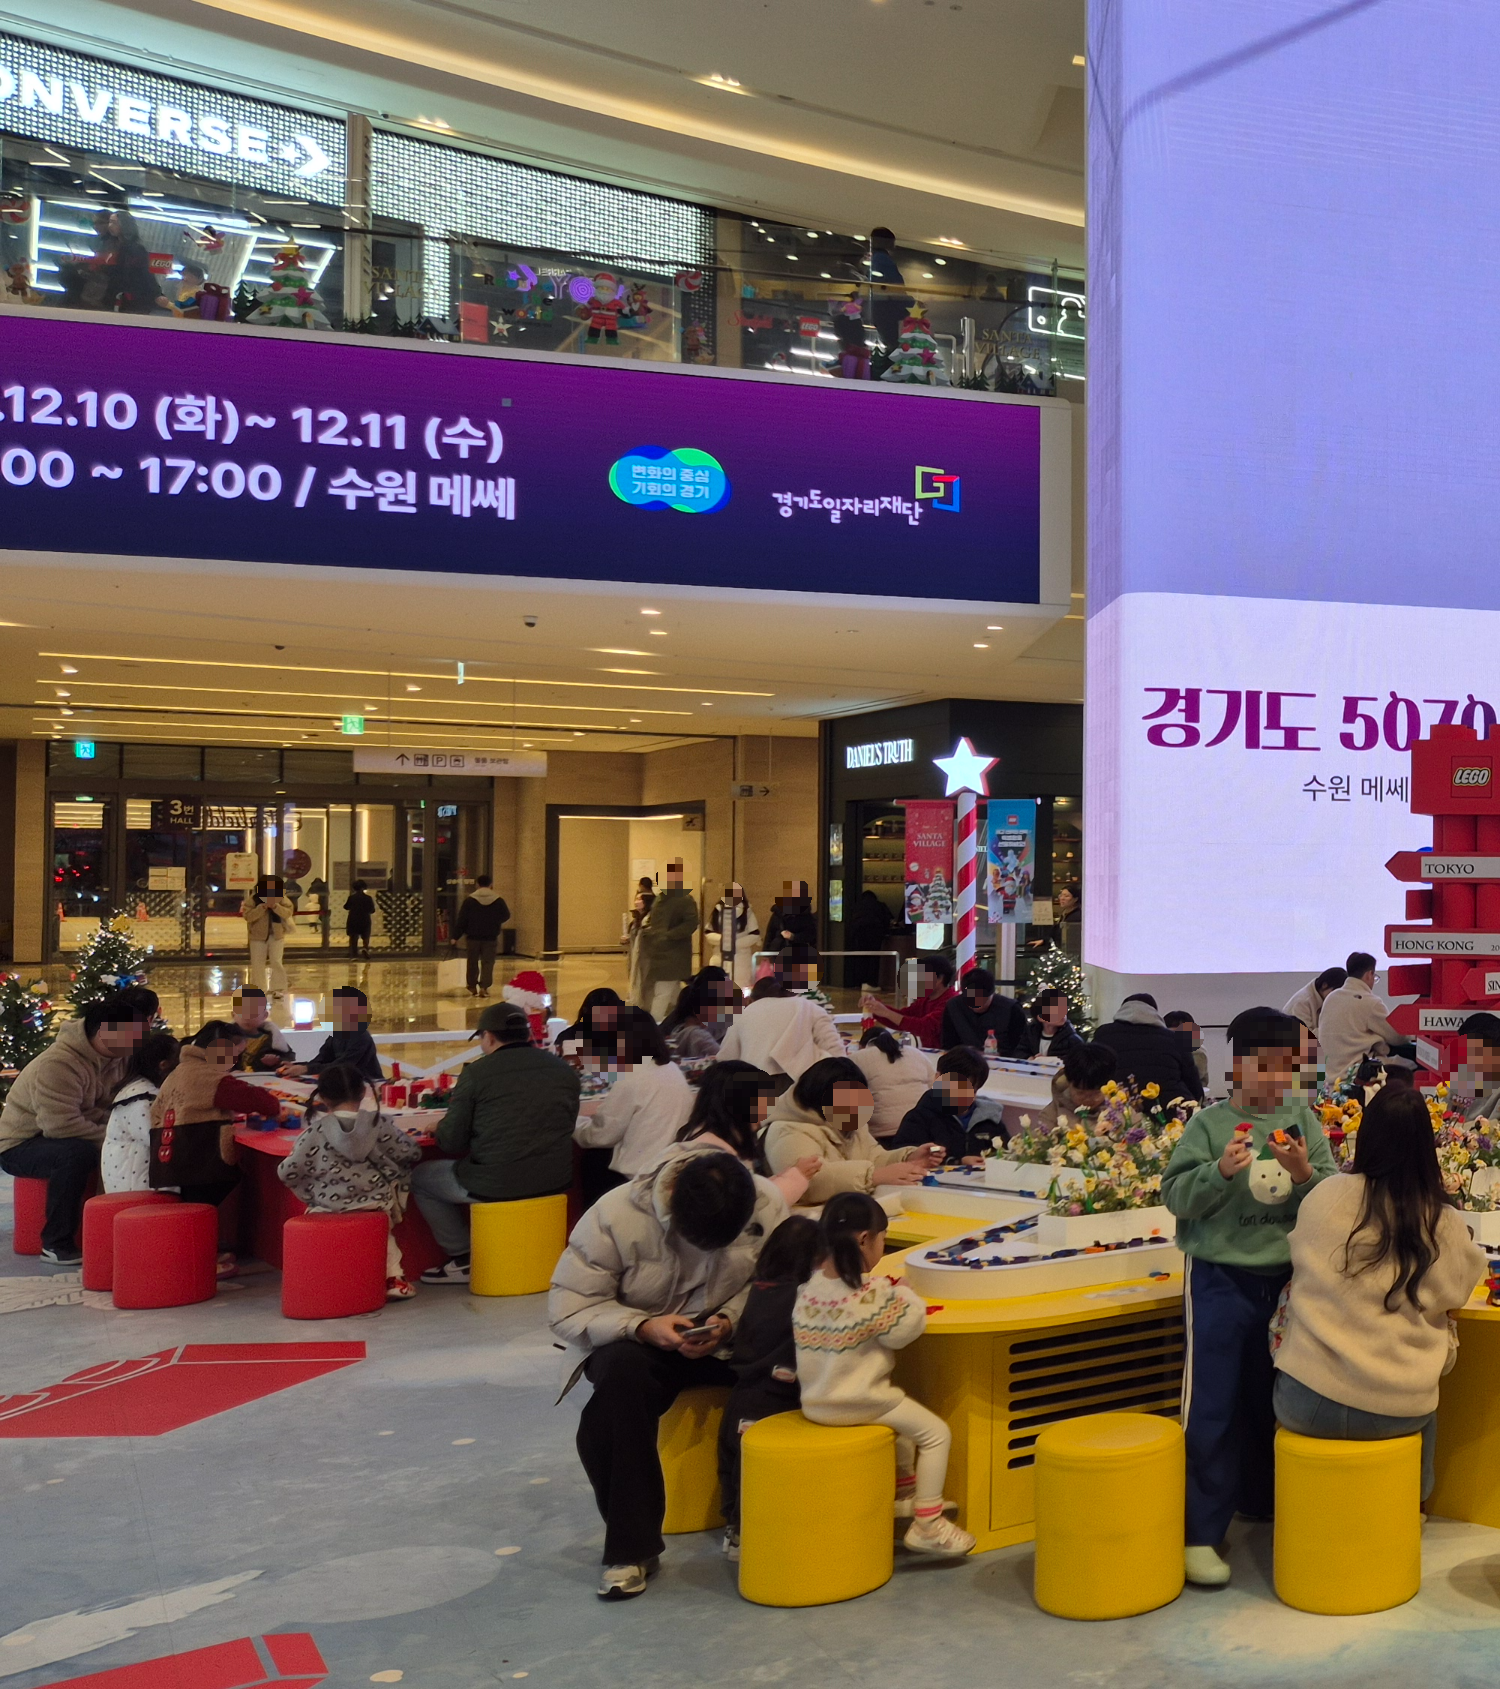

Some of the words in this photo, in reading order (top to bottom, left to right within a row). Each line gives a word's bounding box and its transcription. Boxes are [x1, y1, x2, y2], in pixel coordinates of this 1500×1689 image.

[982, 328, 1033, 345] SANTA
[292, 408, 406, 450] 12.11
[425, 417, 503, 463] (수)
[631, 464, 677, 482] 변화의
[678, 466, 710, 484] 중심
[1, 448, 75, 489] 00
[92, 465, 124, 480] ~
[140, 457, 282, 500] 17:00
[294, 466, 316, 508] /
[328, 466, 417, 514] 수원
[429, 475, 517, 521] 메쎄
[631, 480, 677, 498] 기회의
[678, 483, 710, 500] 경기
[772, 488, 924, 527] 경기도일자리재단
[1142, 686, 1322, 751] 경기도
[846, 743, 884, 769] DANIEL'S
[882, 739, 914, 764] TRUTH
[1453, 768, 1491, 787] LEGO
[1302, 774, 1351, 802] 수원
[1360, 775, 1410, 802] 메쎄
[169, 816, 194, 825] HALL
[913, 840, 946, 848] VILLAGE
[916, 832, 943, 841] SANTA
[1424, 863, 1475, 875] TOKYO
[1395, 940, 1434, 951] HONG
[1437, 940, 1475, 951] KONG
[1424, 1017, 1467, 1027] HAWA
